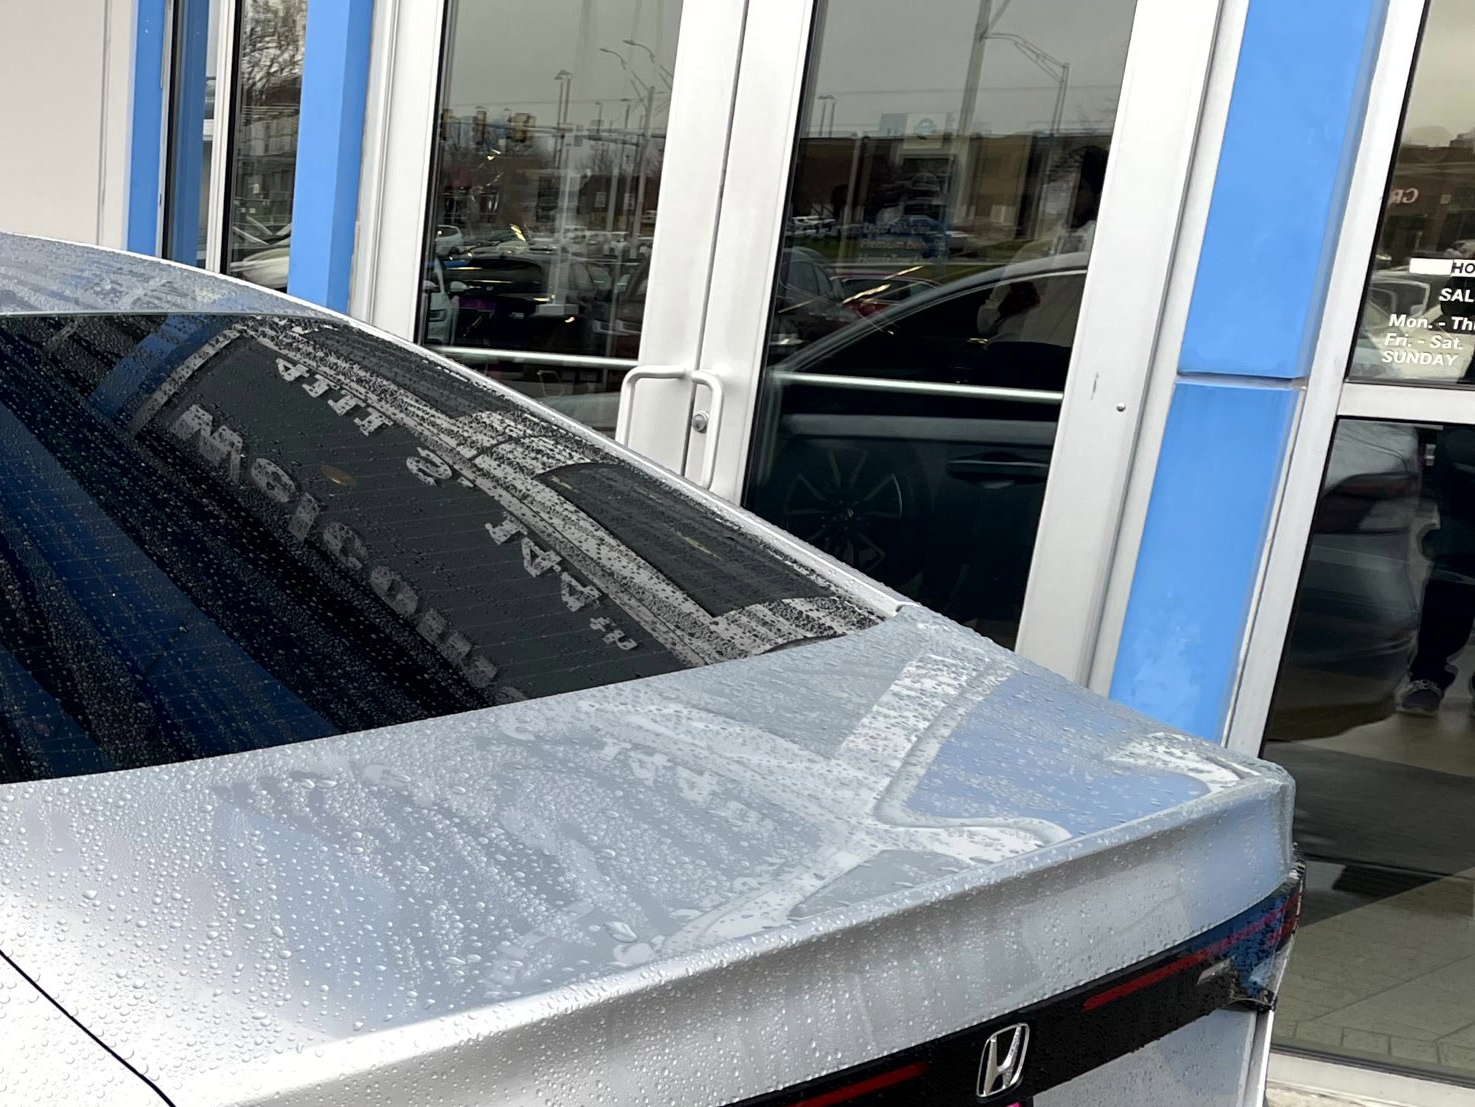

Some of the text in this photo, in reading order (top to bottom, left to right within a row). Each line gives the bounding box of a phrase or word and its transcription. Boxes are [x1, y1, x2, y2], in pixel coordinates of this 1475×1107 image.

[1388, 313, 1433, 329] Mon.
[1451, 317, 1475, 331] Th
[1384, 332, 1412, 348] Fri.
[1429, 335, 1464, 350] Sat.
[1381, 350, 1458, 366] SUNDAY
